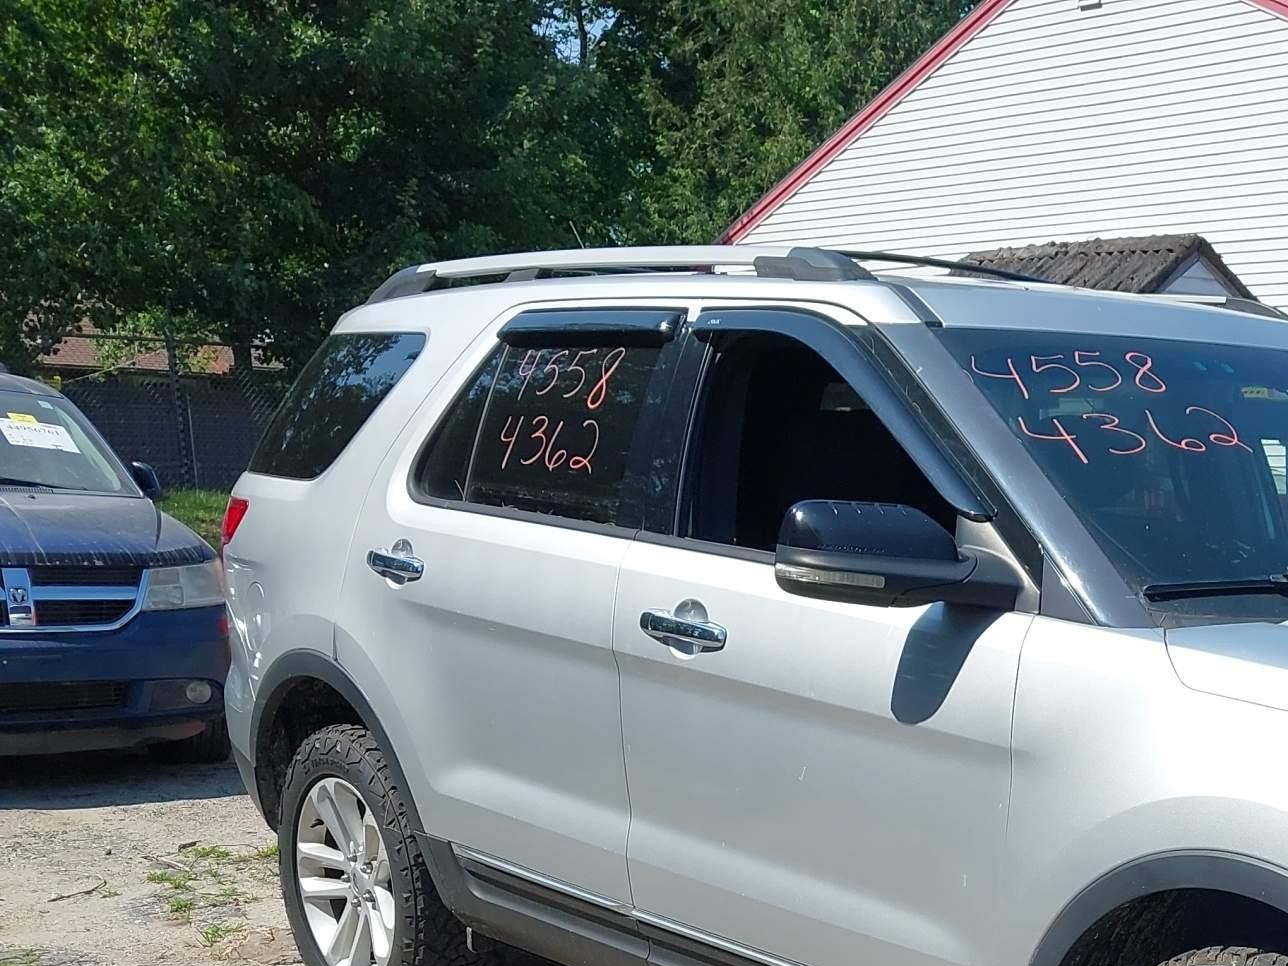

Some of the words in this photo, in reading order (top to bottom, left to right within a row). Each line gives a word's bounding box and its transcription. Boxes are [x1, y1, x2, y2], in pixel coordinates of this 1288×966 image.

[517, 347, 626, 410] 4558
[971, 350, 1167, 400] 4558
[500, 414, 600, 475] 4362
[1017, 405, 1254, 464] 4362
